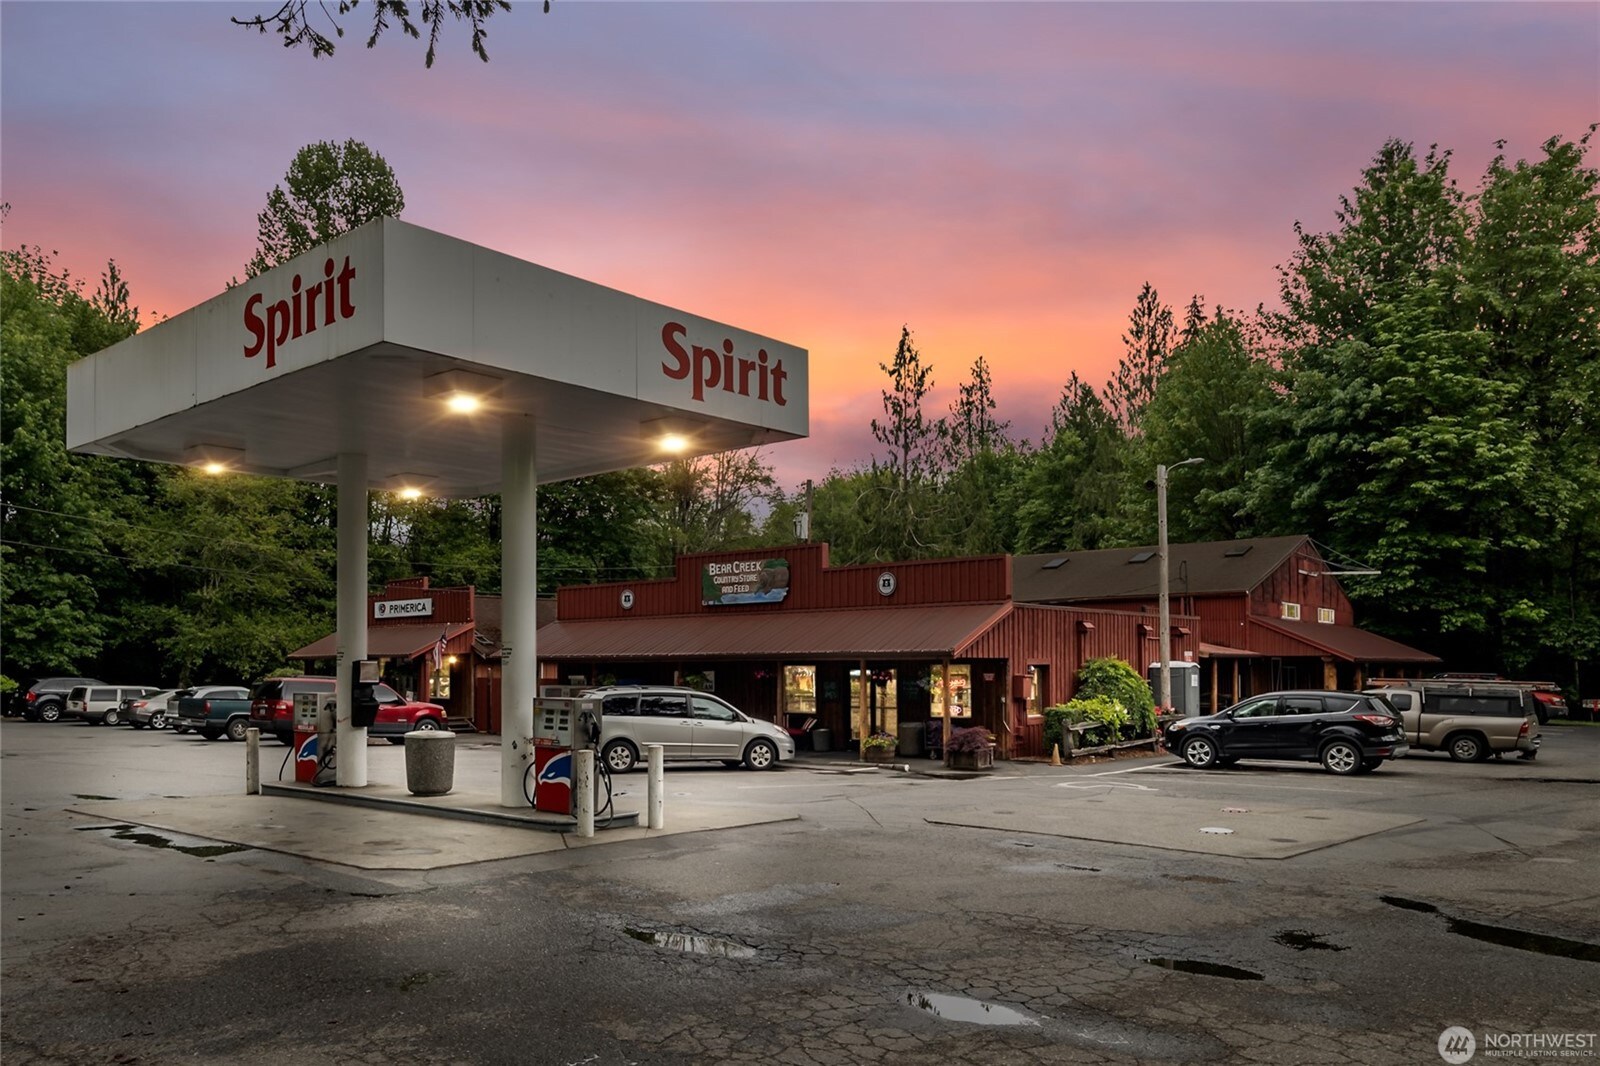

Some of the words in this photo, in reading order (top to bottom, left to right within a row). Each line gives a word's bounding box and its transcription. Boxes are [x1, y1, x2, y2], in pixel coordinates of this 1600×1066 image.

[243, 255, 356, 368] Spirit
[661, 321, 788, 406] Spirit
[709, 563, 732, 576] BEAR
[733, 561, 762, 573] CREEK
[714, 576, 738, 584] COUNTRY
[739, 574, 758, 582] STORE
[734, 584, 750, 592] FEED
[389, 602, 427, 614] PRIMERICA
